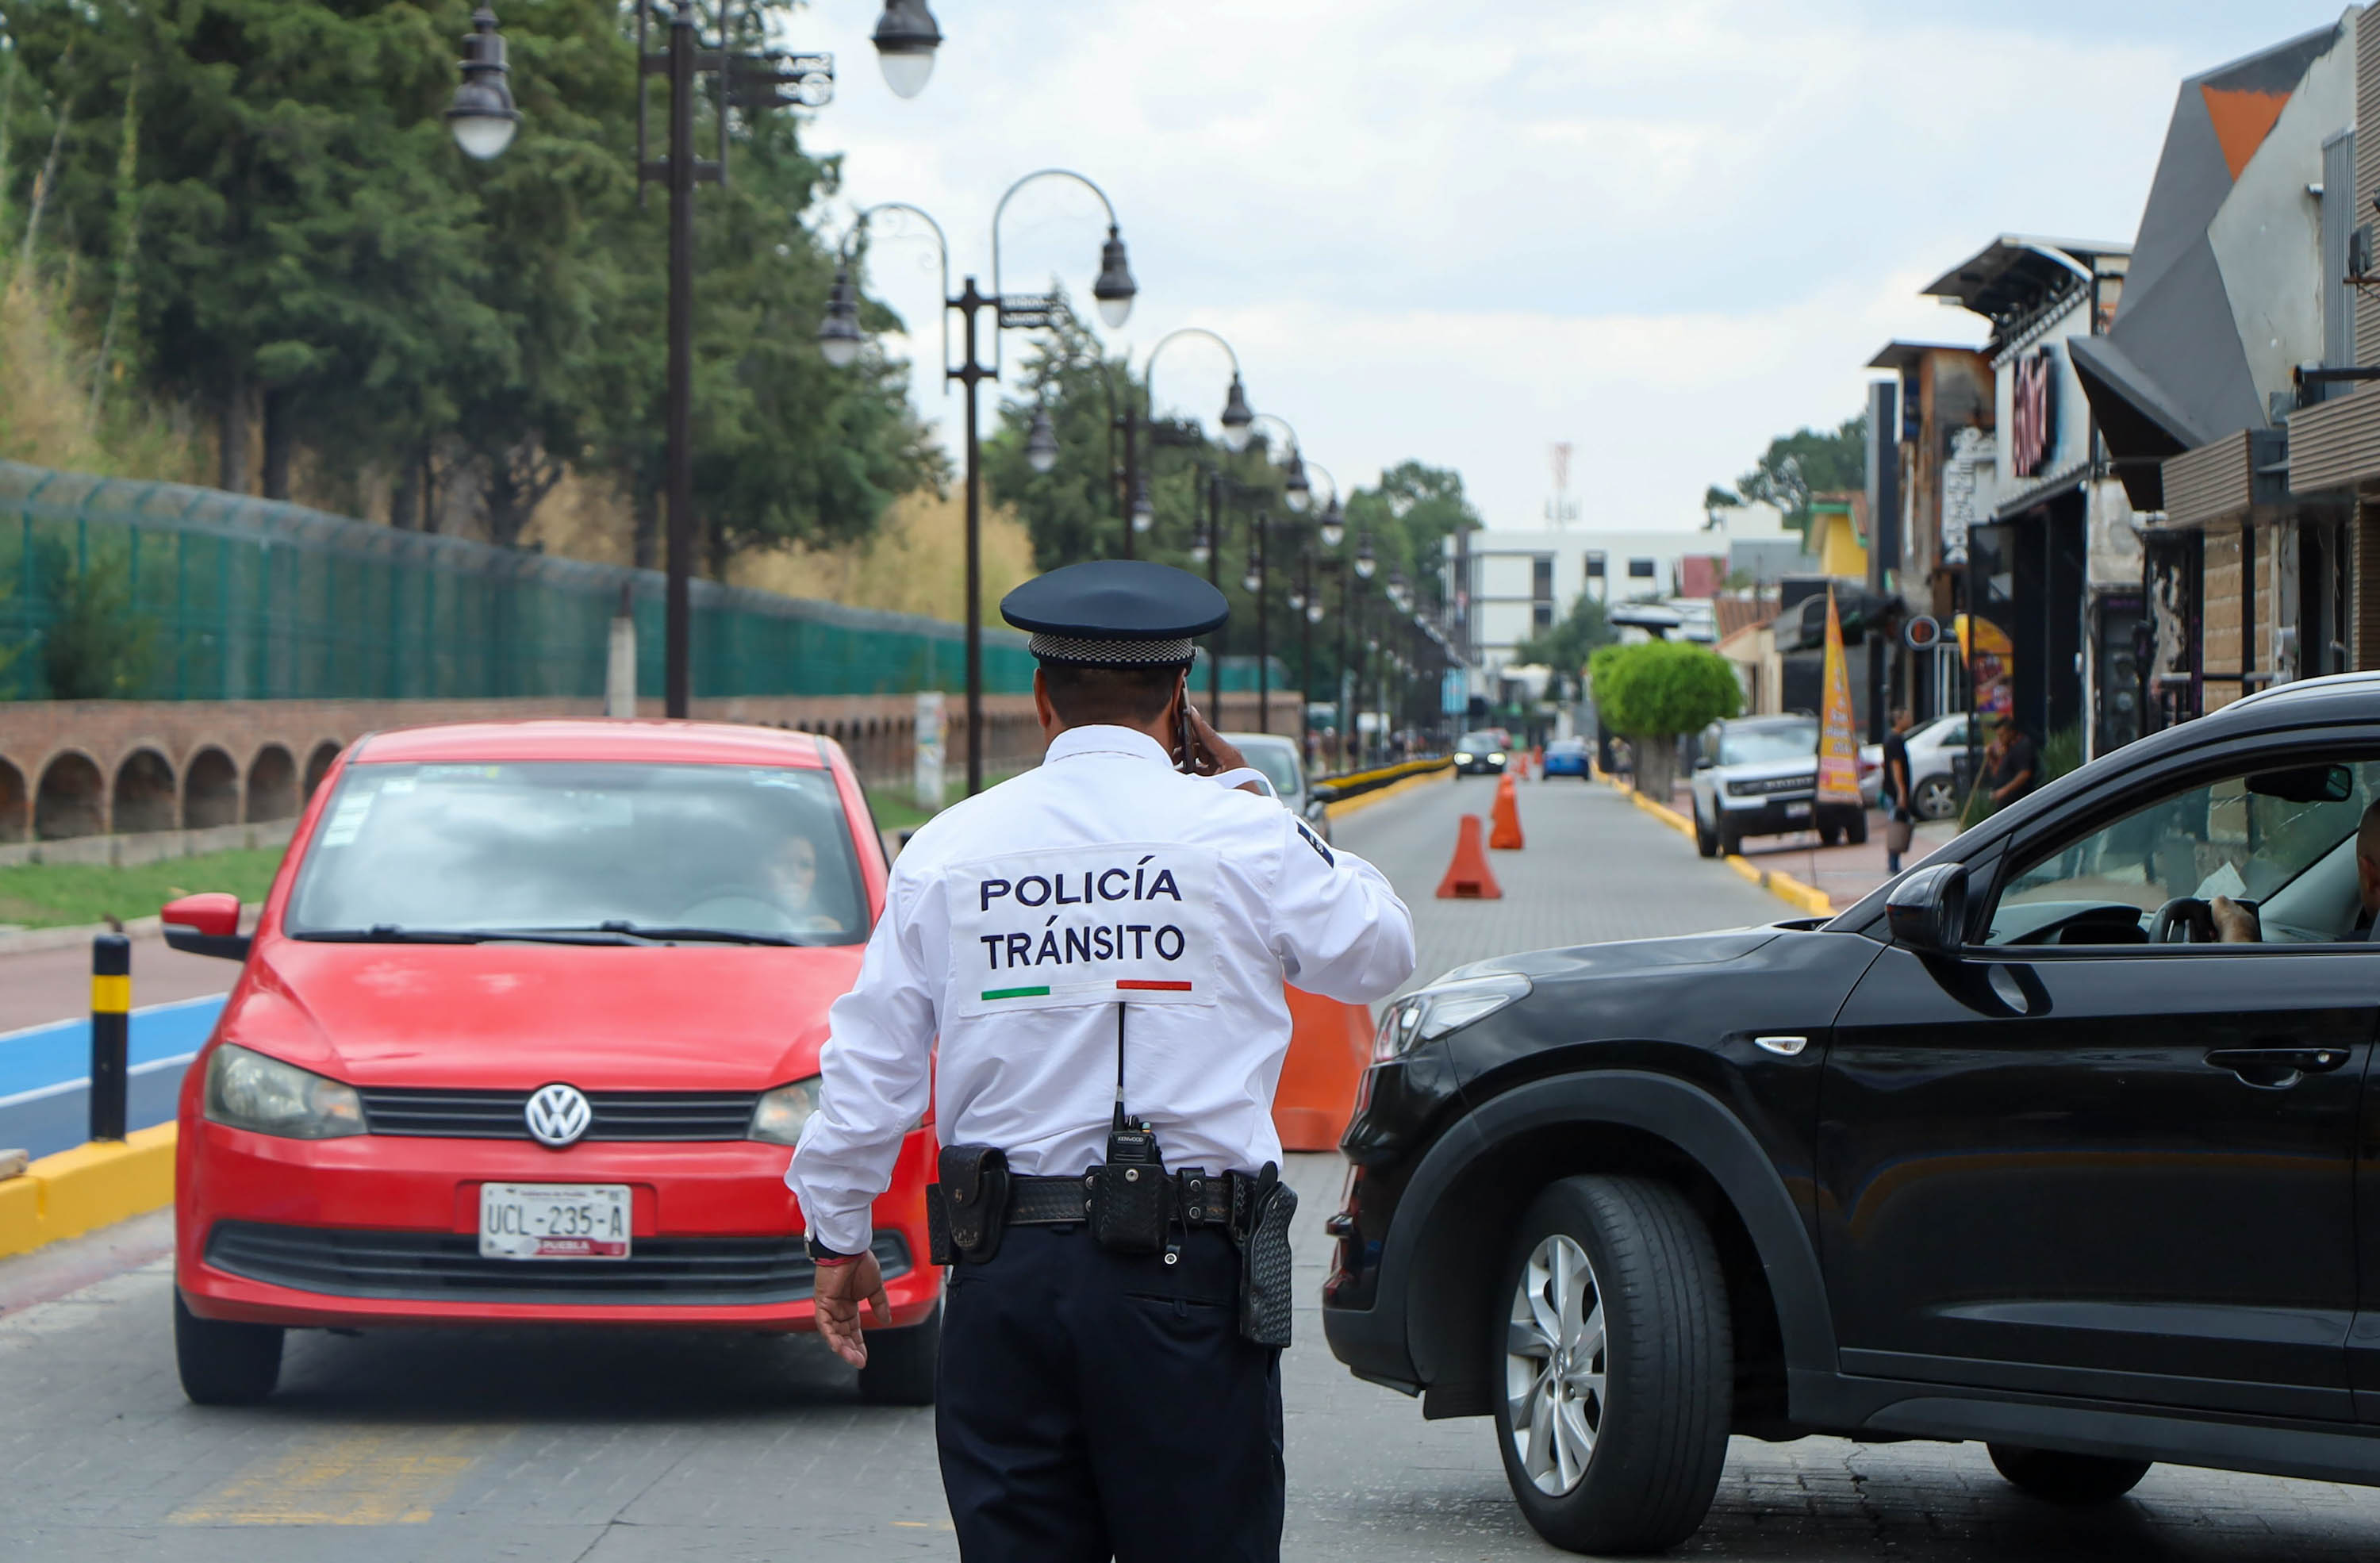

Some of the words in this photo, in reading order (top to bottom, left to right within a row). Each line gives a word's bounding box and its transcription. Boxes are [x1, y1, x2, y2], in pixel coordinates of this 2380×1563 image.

[980, 854, 1182, 912] POLICÍA
[980, 914, 1185, 970] TRÁNSITO
[487, 1204, 624, 1237] UCL-235-A
[541, 1239, 590, 1250] PUEBLA
